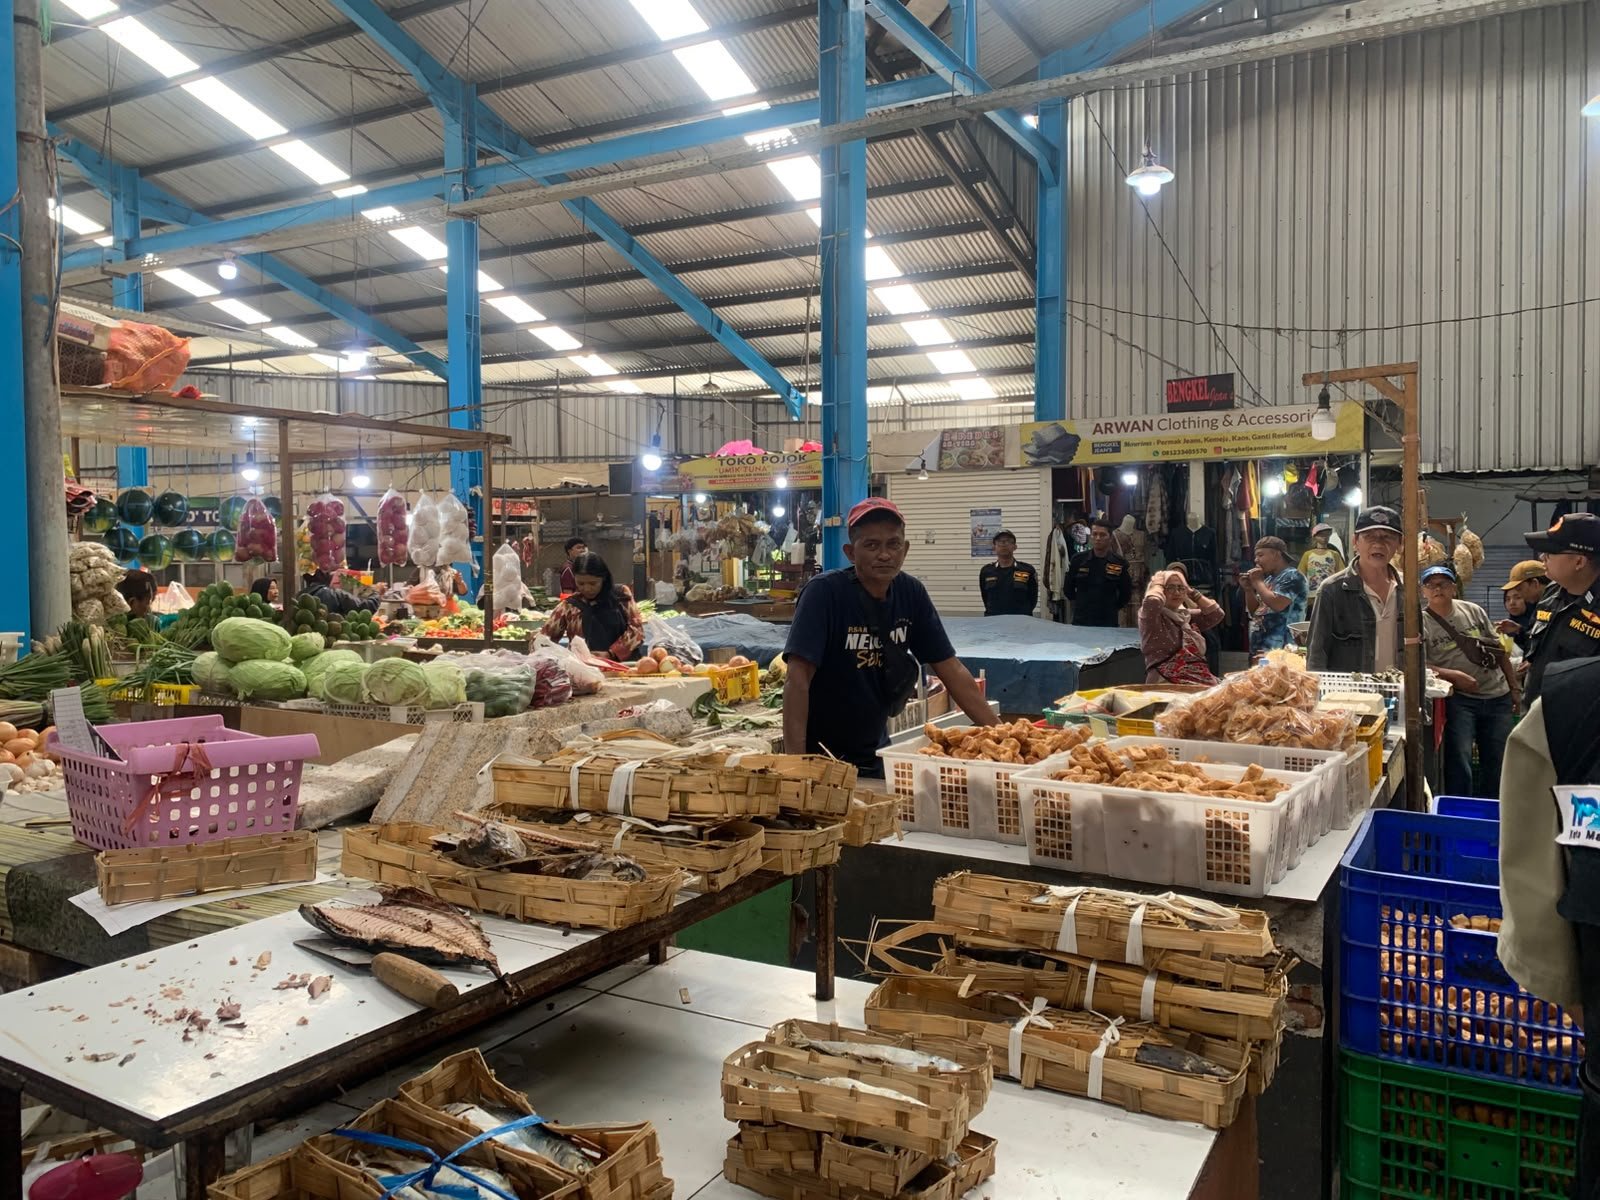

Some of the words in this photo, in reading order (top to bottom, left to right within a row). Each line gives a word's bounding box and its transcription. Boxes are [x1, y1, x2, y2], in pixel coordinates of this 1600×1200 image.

[1167, 377, 1209, 404] BENGKEL
[1092, 419, 1153, 435] ARWAN
[1157, 416, 1219, 431] Clothing
[1222, 414, 1233, 427] &
[1236, 408, 1313, 426] Accessori
[718, 457, 756, 466] TOKO
[761, 454, 807, 464] POJOK
